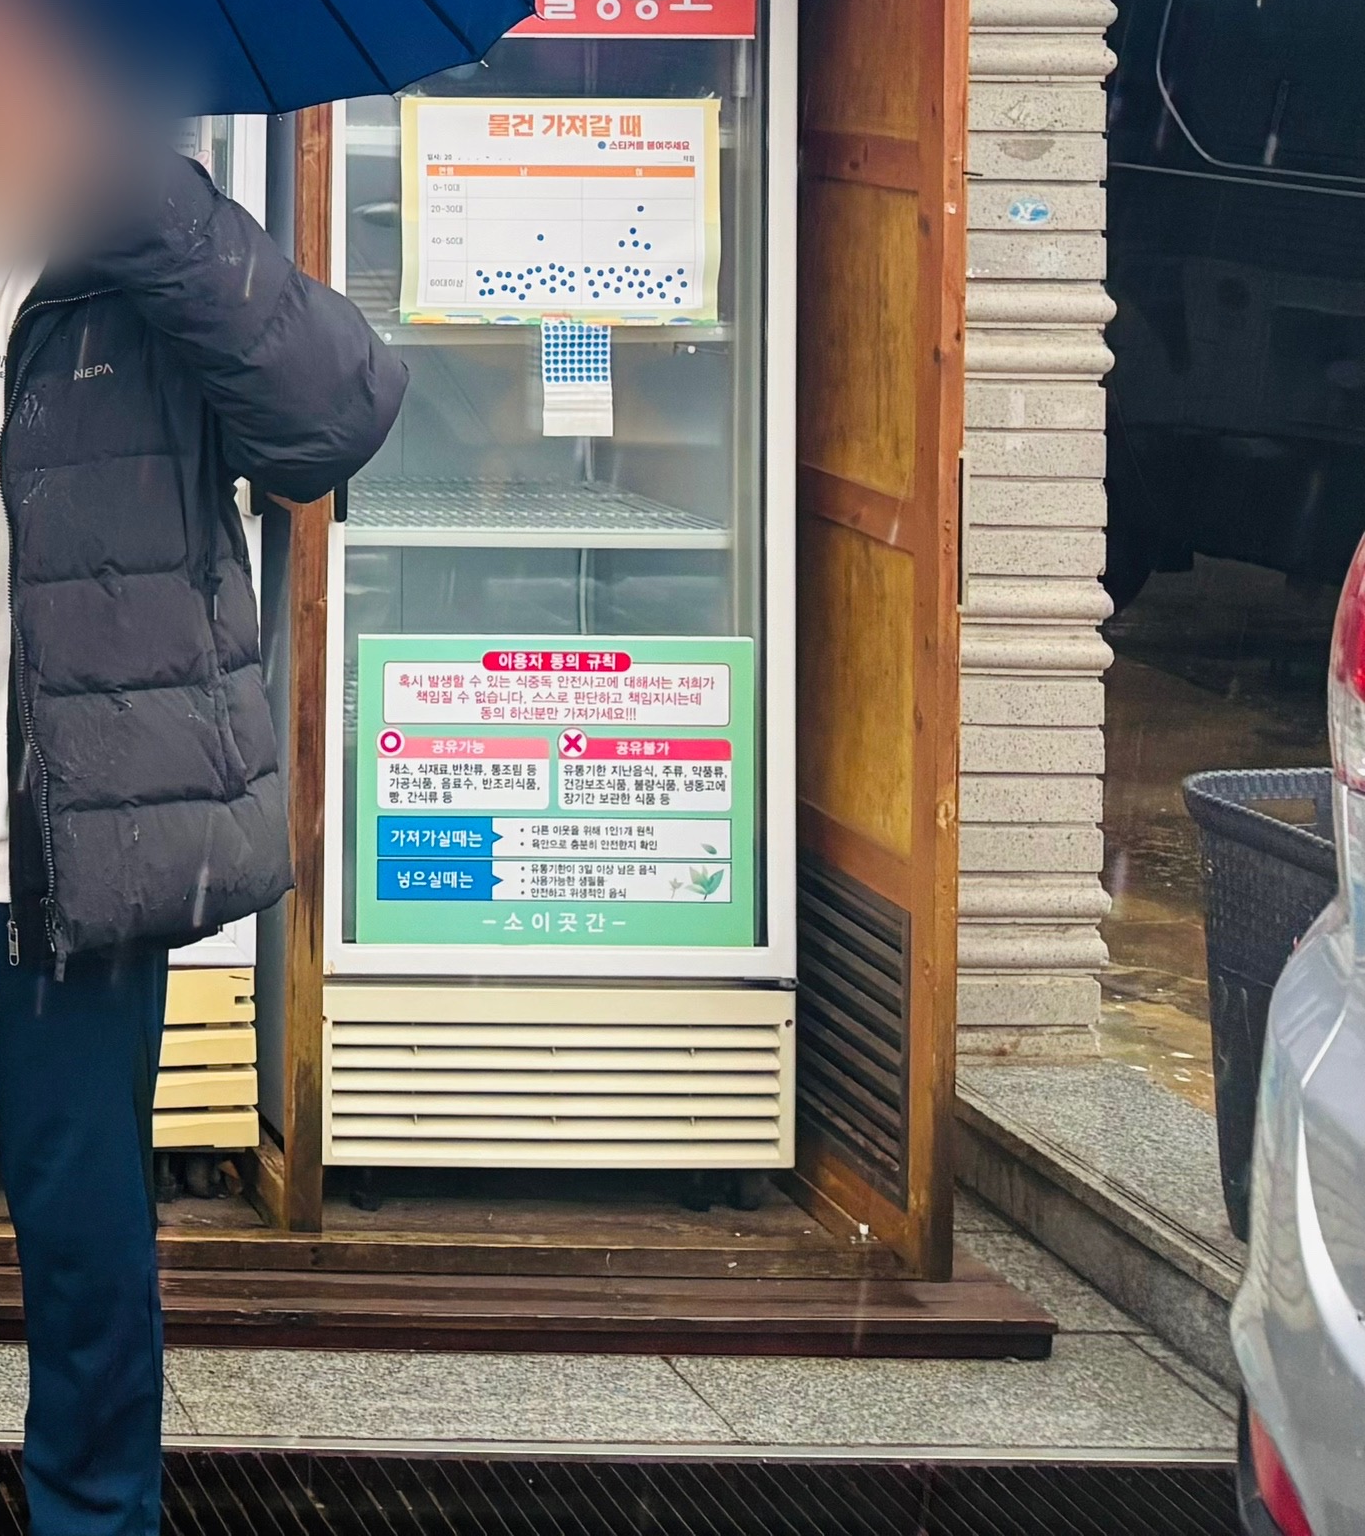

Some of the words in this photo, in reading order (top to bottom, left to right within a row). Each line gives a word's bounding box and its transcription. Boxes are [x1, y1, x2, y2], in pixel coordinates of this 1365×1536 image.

[488, 114, 534, 137] 물건
[542, 114, 612, 137] 가져갈
[619, 115, 642, 138] 때
[609, 140, 644, 150] 스티커를
[647, 141, 690, 150] 붙여주세요
[73, 363, 114, 381] NEPA
[498, 652, 543, 670] 이용자
[550, 652, 580, 670] 동의
[587, 652, 616, 671] 규칙
[399, 673, 423, 688] 혹시
[428, 674, 464, 688] 발생할
[469, 674, 482, 688] 수
[486, 675, 511, 688] 있는
[516, 675, 552, 688] 식중독
[557, 675, 619, 689] 안전사고에
[624, 676, 673, 689] 대해서는
[678, 676, 715, 690] 저희가
[416, 690, 452, 704] 책임질
[457, 690, 470, 704] 수
[531, 691, 569, 704] 스스로
[574, 692, 623, 705] 판단하고
[628, 692, 702, 706] 책임지시는데
[480, 706, 505, 720] 동의
[509, 706, 558, 720] 하신분만
[564, 707, 637, 721] 가져가세요!!!
[431, 739, 485, 754] 공유가능
[615, 741, 670, 756] 공유불가
[491, 764, 523, 776] 통조림
[526, 765, 538, 776] 등
[563, 765, 607, 777] 유통기한
[684, 780, 726, 792] 냉동고에
[407, 791, 439, 804] 간식류
[442, 792, 453, 804] 등
[563, 793, 595, 805] 장기간
[599, 793, 631, 805] 보관한
[635, 794, 656, 806] 식품
[659, 794, 671, 806] 등
[531, 825, 549, 836] 다른
[553, 825, 579, 836] 이웃을
[583, 825, 601, 836] 위해
[604, 826, 633, 836] 1인1개
[636, 826, 655, 836] 원칙
[390, 830, 483, 848] 가져가실때는
[532, 839, 567, 849] 육안으로
[570, 839, 597, 850] 충분히
[600, 840, 637, 850] 안전한지
[640, 840, 658, 851] 확인
[530, 864, 575, 875] 유통기한이
[578, 864, 593, 875] 3일
[596, 865, 614, 875] 이상
[639, 865, 657, 875] 음식
[397, 871, 474, 889] 넣으실때는
[530, 876, 575, 886] 사용가능한
[530, 888, 566, 898] 안전하고
[569, 888, 606, 898] 위생적인
[609, 888, 627, 898] 음식
